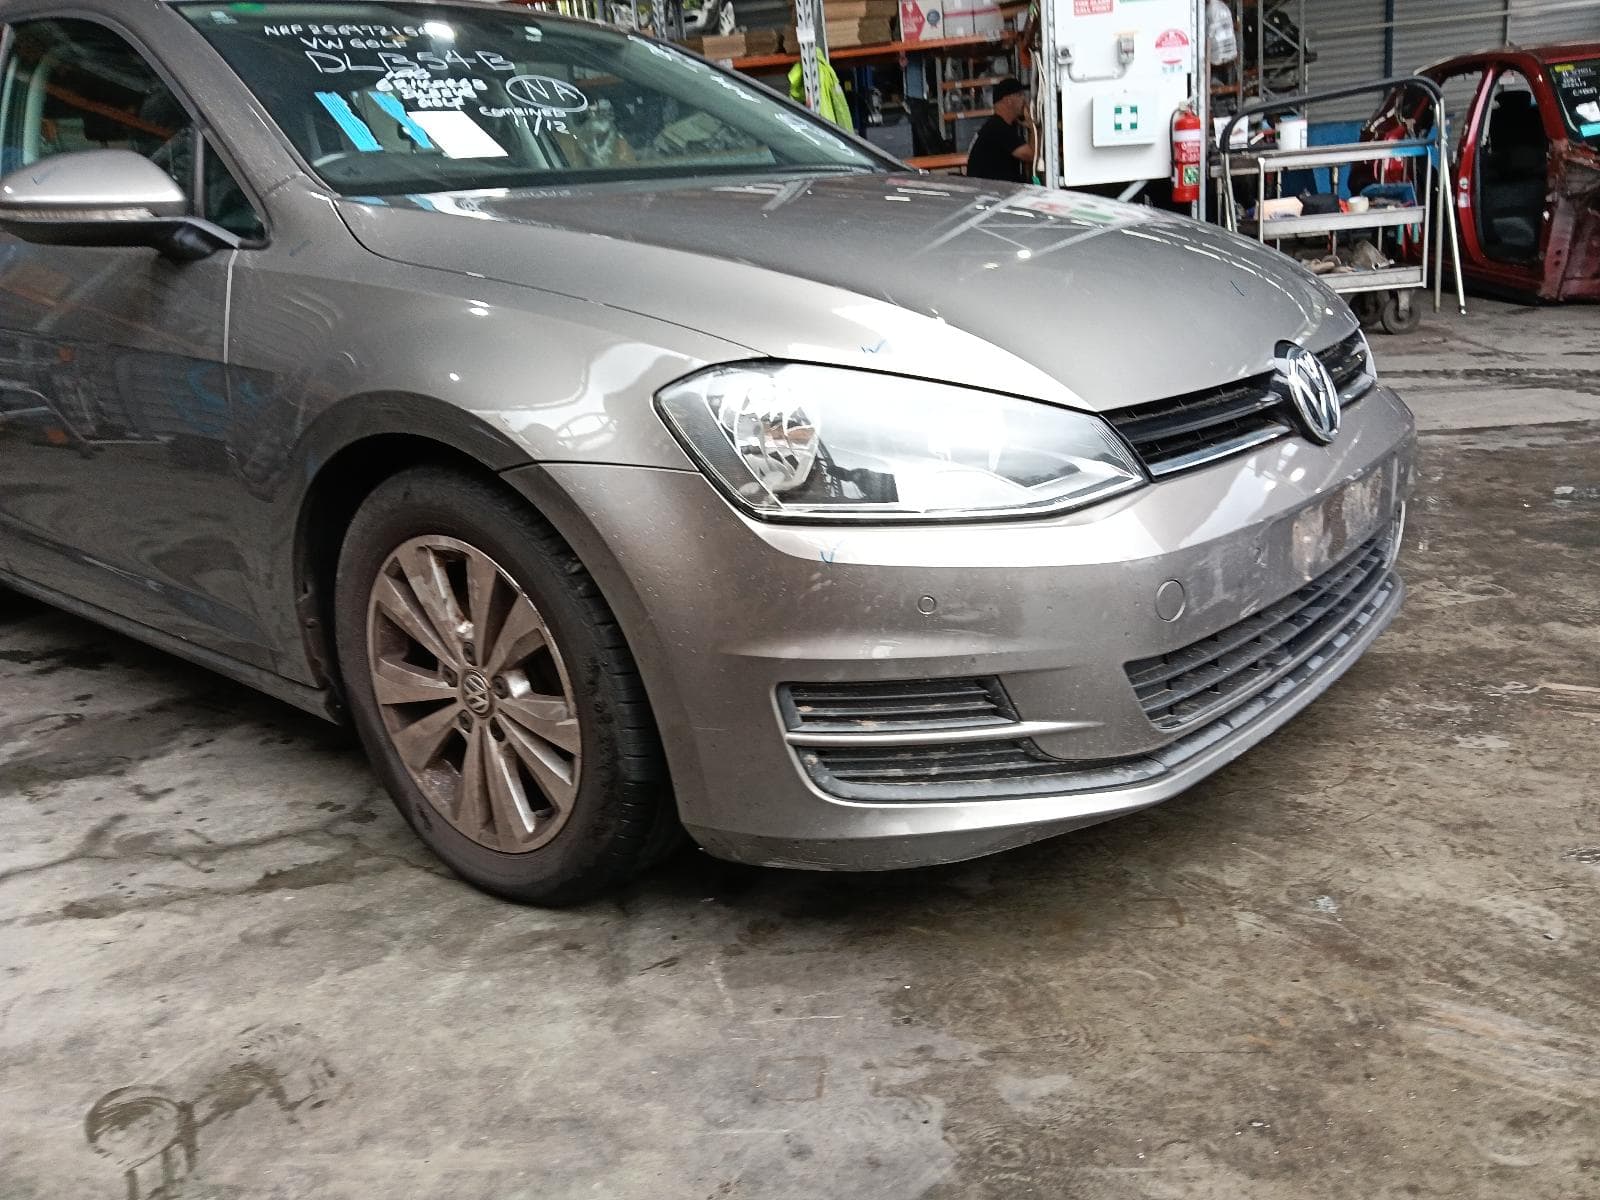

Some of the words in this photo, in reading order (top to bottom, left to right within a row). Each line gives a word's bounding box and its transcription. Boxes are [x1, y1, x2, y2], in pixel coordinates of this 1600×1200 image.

[300, 37, 343, 50] VW
[349, 38, 408, 49] GOLF
[521, 78, 578, 101] NA
